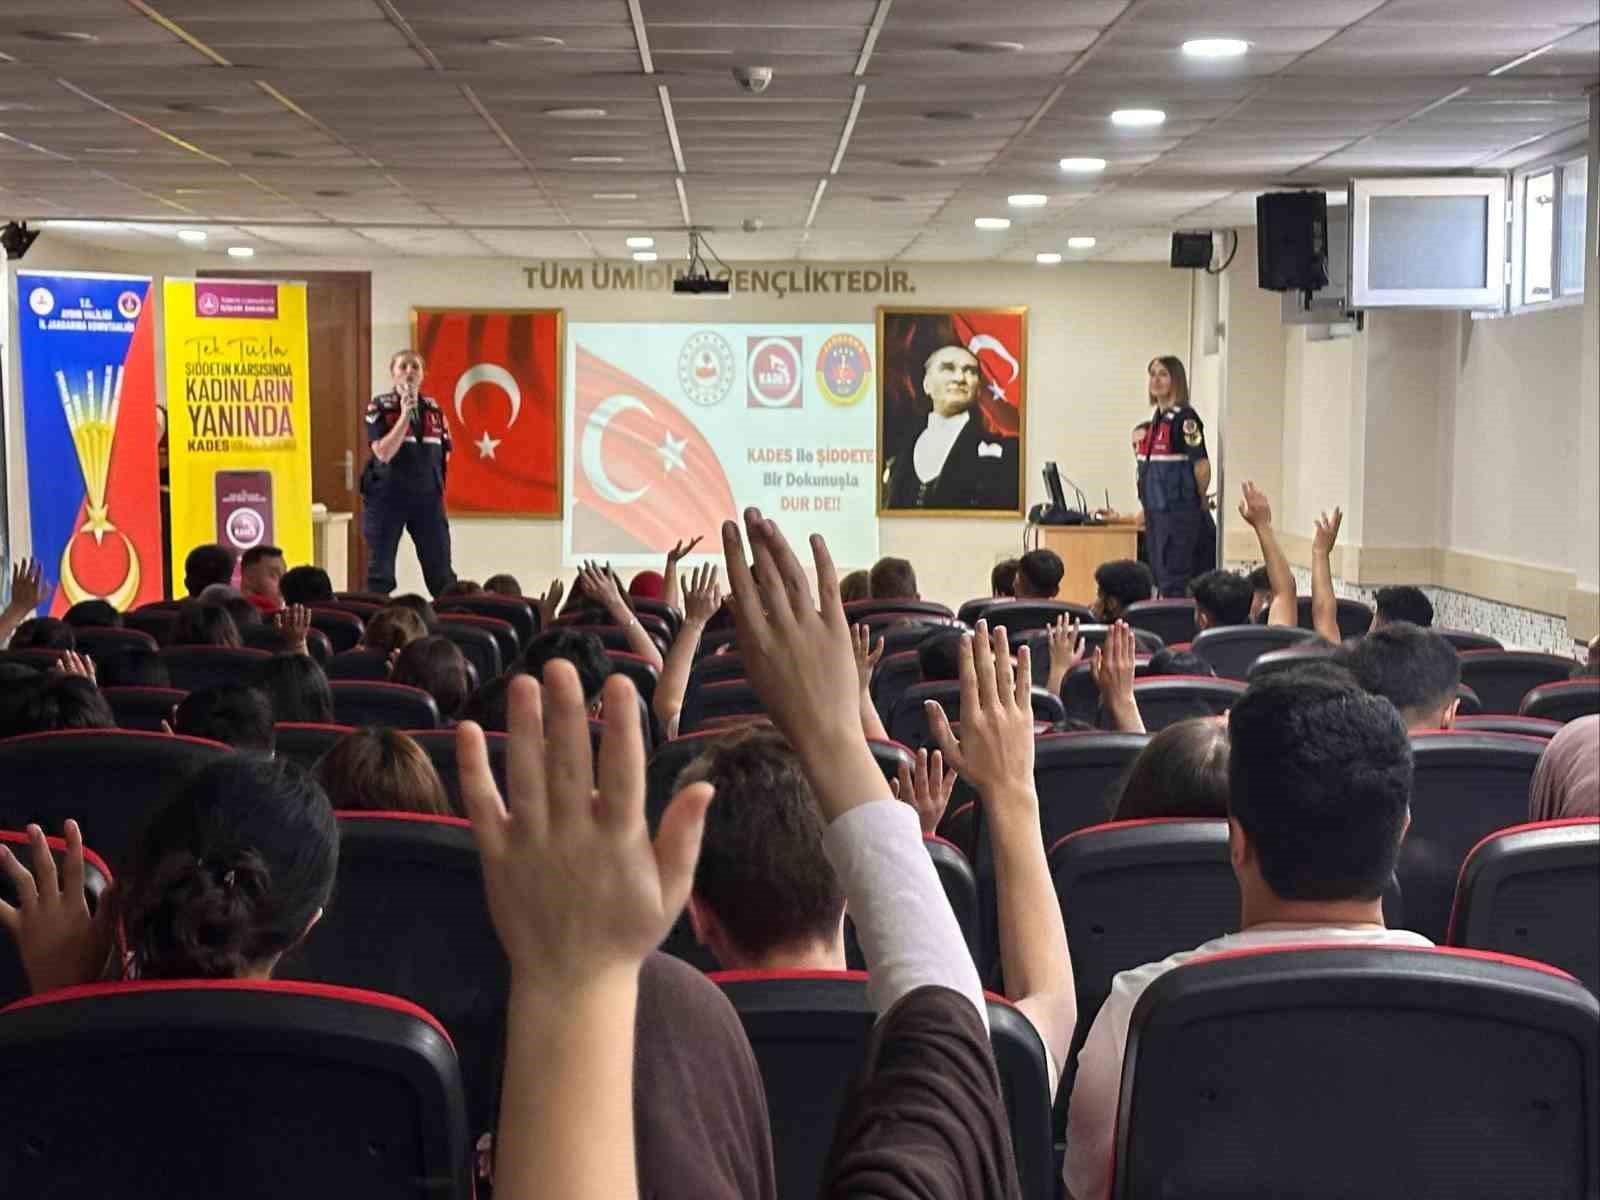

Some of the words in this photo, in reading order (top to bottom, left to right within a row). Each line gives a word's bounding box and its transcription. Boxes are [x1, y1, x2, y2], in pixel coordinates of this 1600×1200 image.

[523, 263, 584, 290] TÜM
[185, 336, 223, 361] Tek
[185, 378, 294, 404] KADINLARIN
[188, 404, 294, 438] YANINDA
[187, 438, 230, 453] KADES
[746, 447, 793, 464] KADES
[785, 471, 859, 491] Dokunuşla
[780, 496, 810, 512] DUR
[813, 496, 841, 512] DE!!
